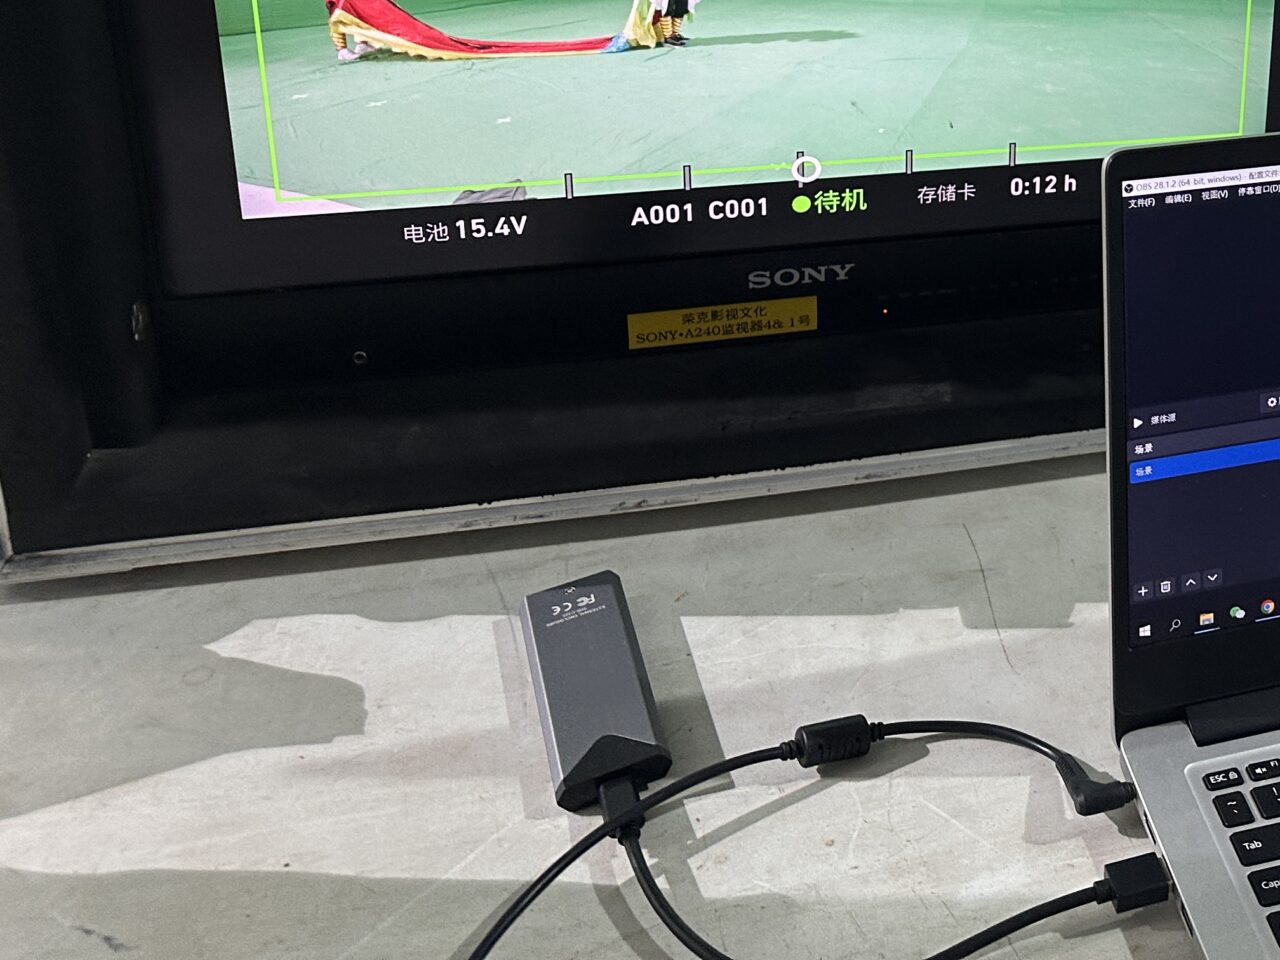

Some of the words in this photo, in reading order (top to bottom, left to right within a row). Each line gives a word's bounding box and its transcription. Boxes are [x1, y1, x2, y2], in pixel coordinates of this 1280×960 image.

[1207, 174, 1242, 185] windows)
[917, 181, 976, 205] 存储卡
[1010, 175, 1058, 196] 0:12
[1063, 173, 1078, 193] h
[1201, 190, 1229, 201] 视图(V)
[814, 187, 868, 214] 待机
[1128, 197, 1155, 209] 文件(F)
[630, 203, 693, 227] A001
[708, 197, 768, 220] C001
[403, 221, 449, 244] 电池
[454, 215, 528, 240] 15.4V
[748, 263, 855, 289] SONY
[682, 305, 767, 325] 荣克影视文化
[1151, 412, 1177, 426] 媒体源
[1134, 443, 1154, 455] 场景
[1136, 466, 1153, 477] 场景
[1209, 773, 1228, 784] ESC
[1243, 841, 1262, 851] Tab
